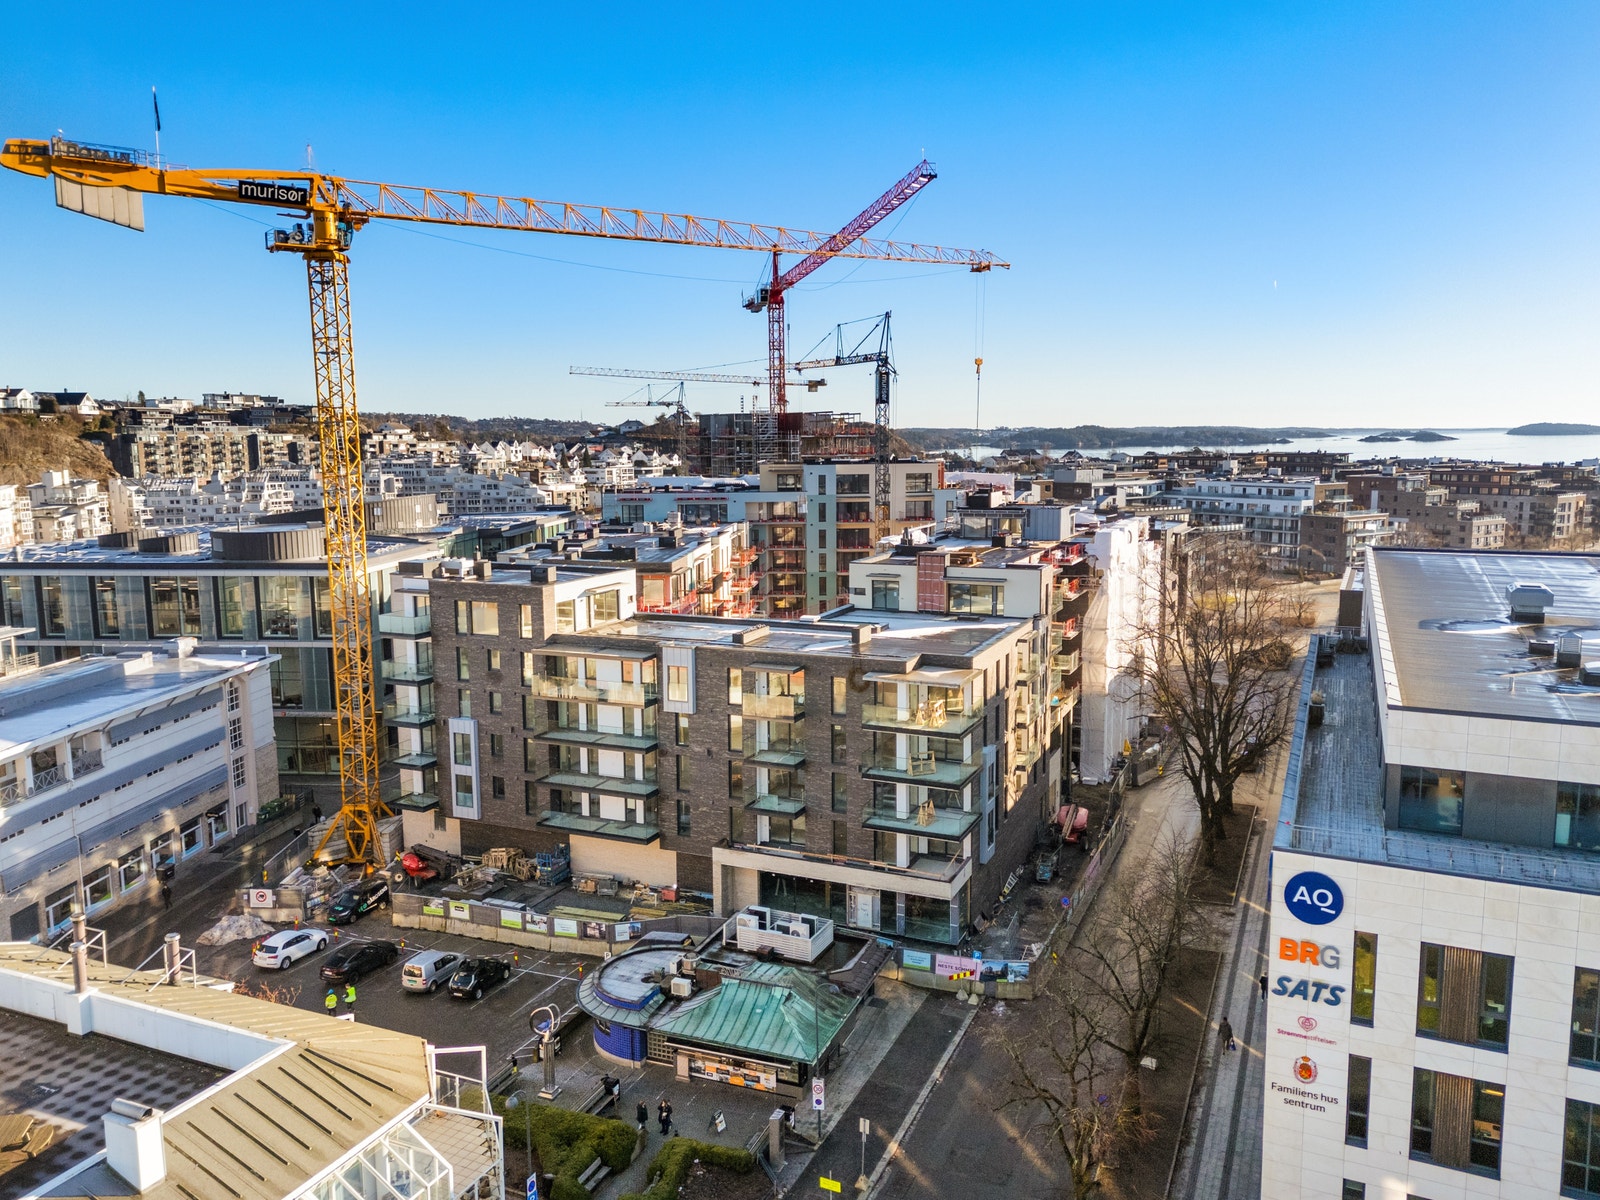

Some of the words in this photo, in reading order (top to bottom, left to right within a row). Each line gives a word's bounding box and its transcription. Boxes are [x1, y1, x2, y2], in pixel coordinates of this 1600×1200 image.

[66, 142, 131, 163] POTAIN
[241, 184, 304, 202] murisør
[1292, 885, 1336, 915] AQ
[1279, 937, 1340, 970] BRG
[1271, 975, 1346, 1007] SATS
[1271, 1082, 1319, 1100] Familiens
[1320, 1092, 1339, 1105] hus
[1283, 1097, 1326, 1113] sentrum
